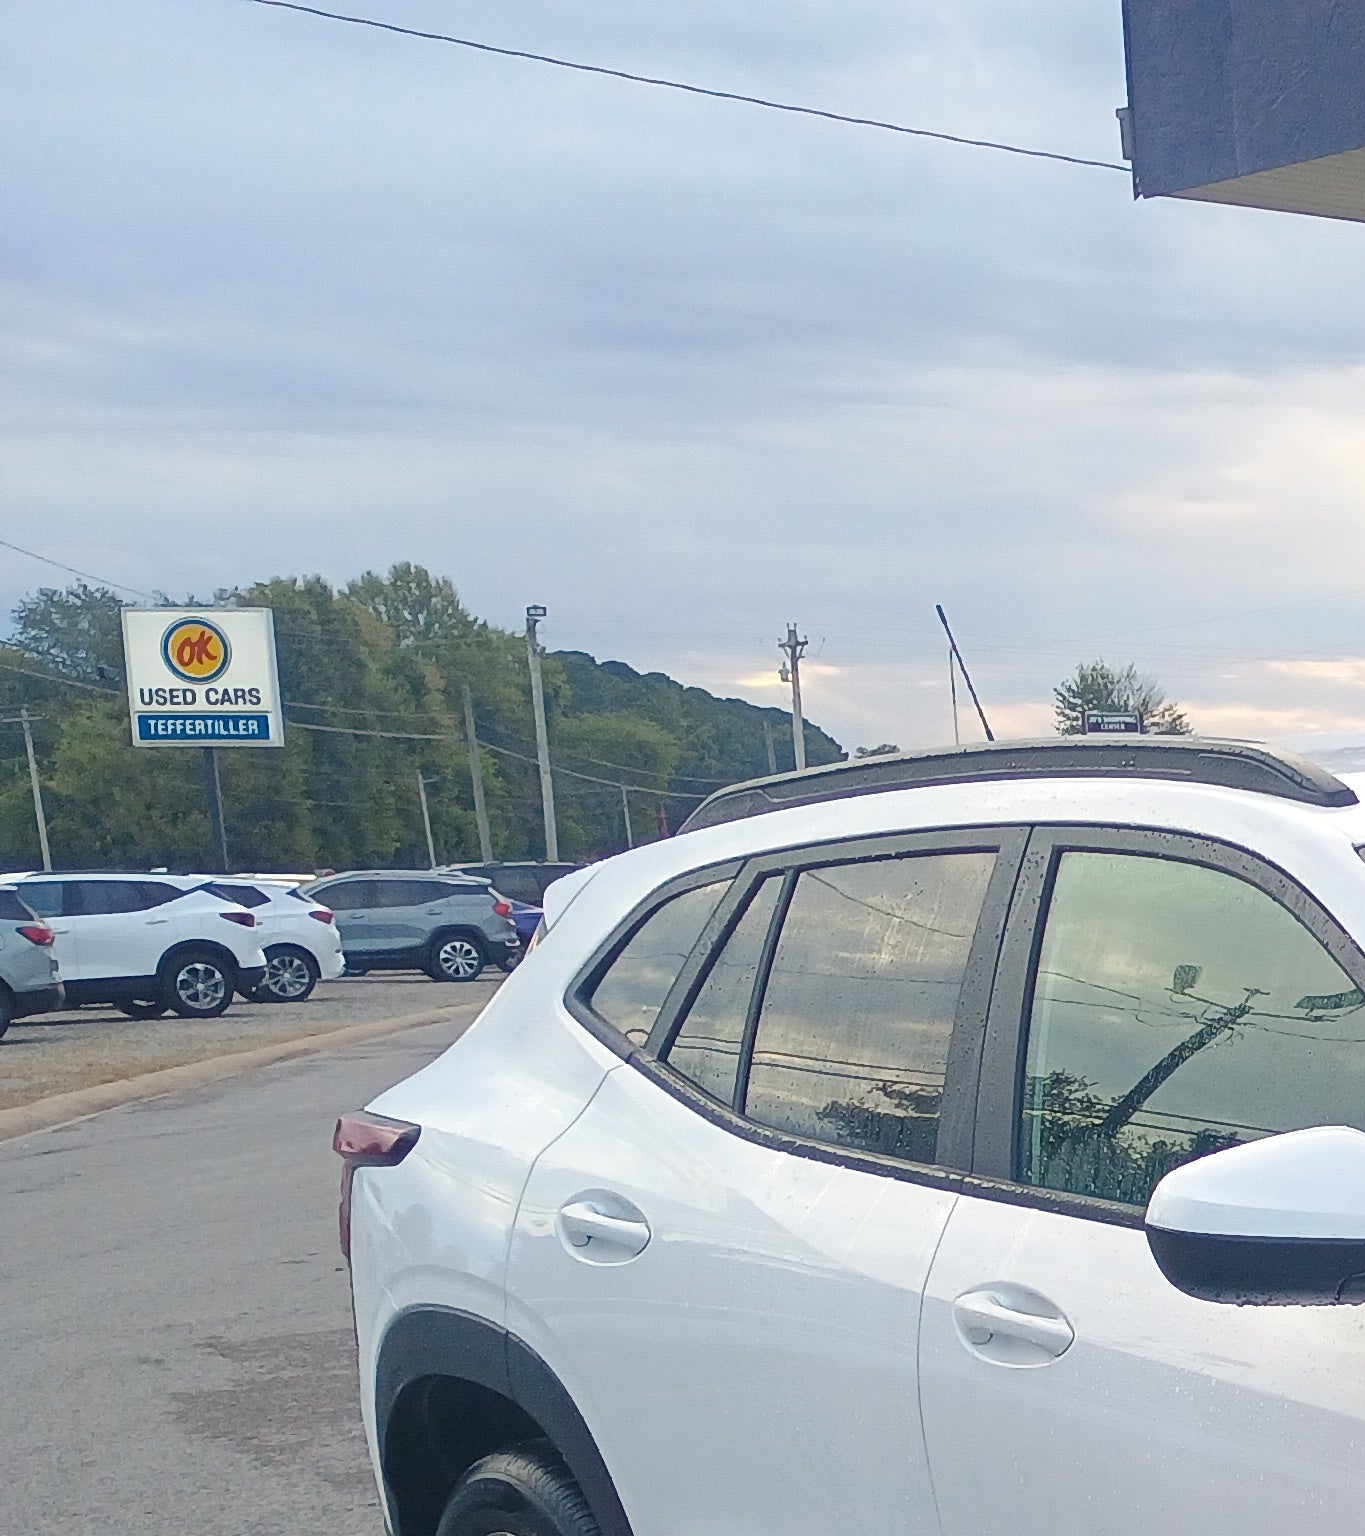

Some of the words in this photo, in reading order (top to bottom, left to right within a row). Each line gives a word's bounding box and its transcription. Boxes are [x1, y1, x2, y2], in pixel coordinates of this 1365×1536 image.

[177, 630, 217, 667] OK
[139, 687, 197, 706] USED
[205, 687, 262, 706] CARS
[148, 719, 259, 736] TEFFERTILLER
